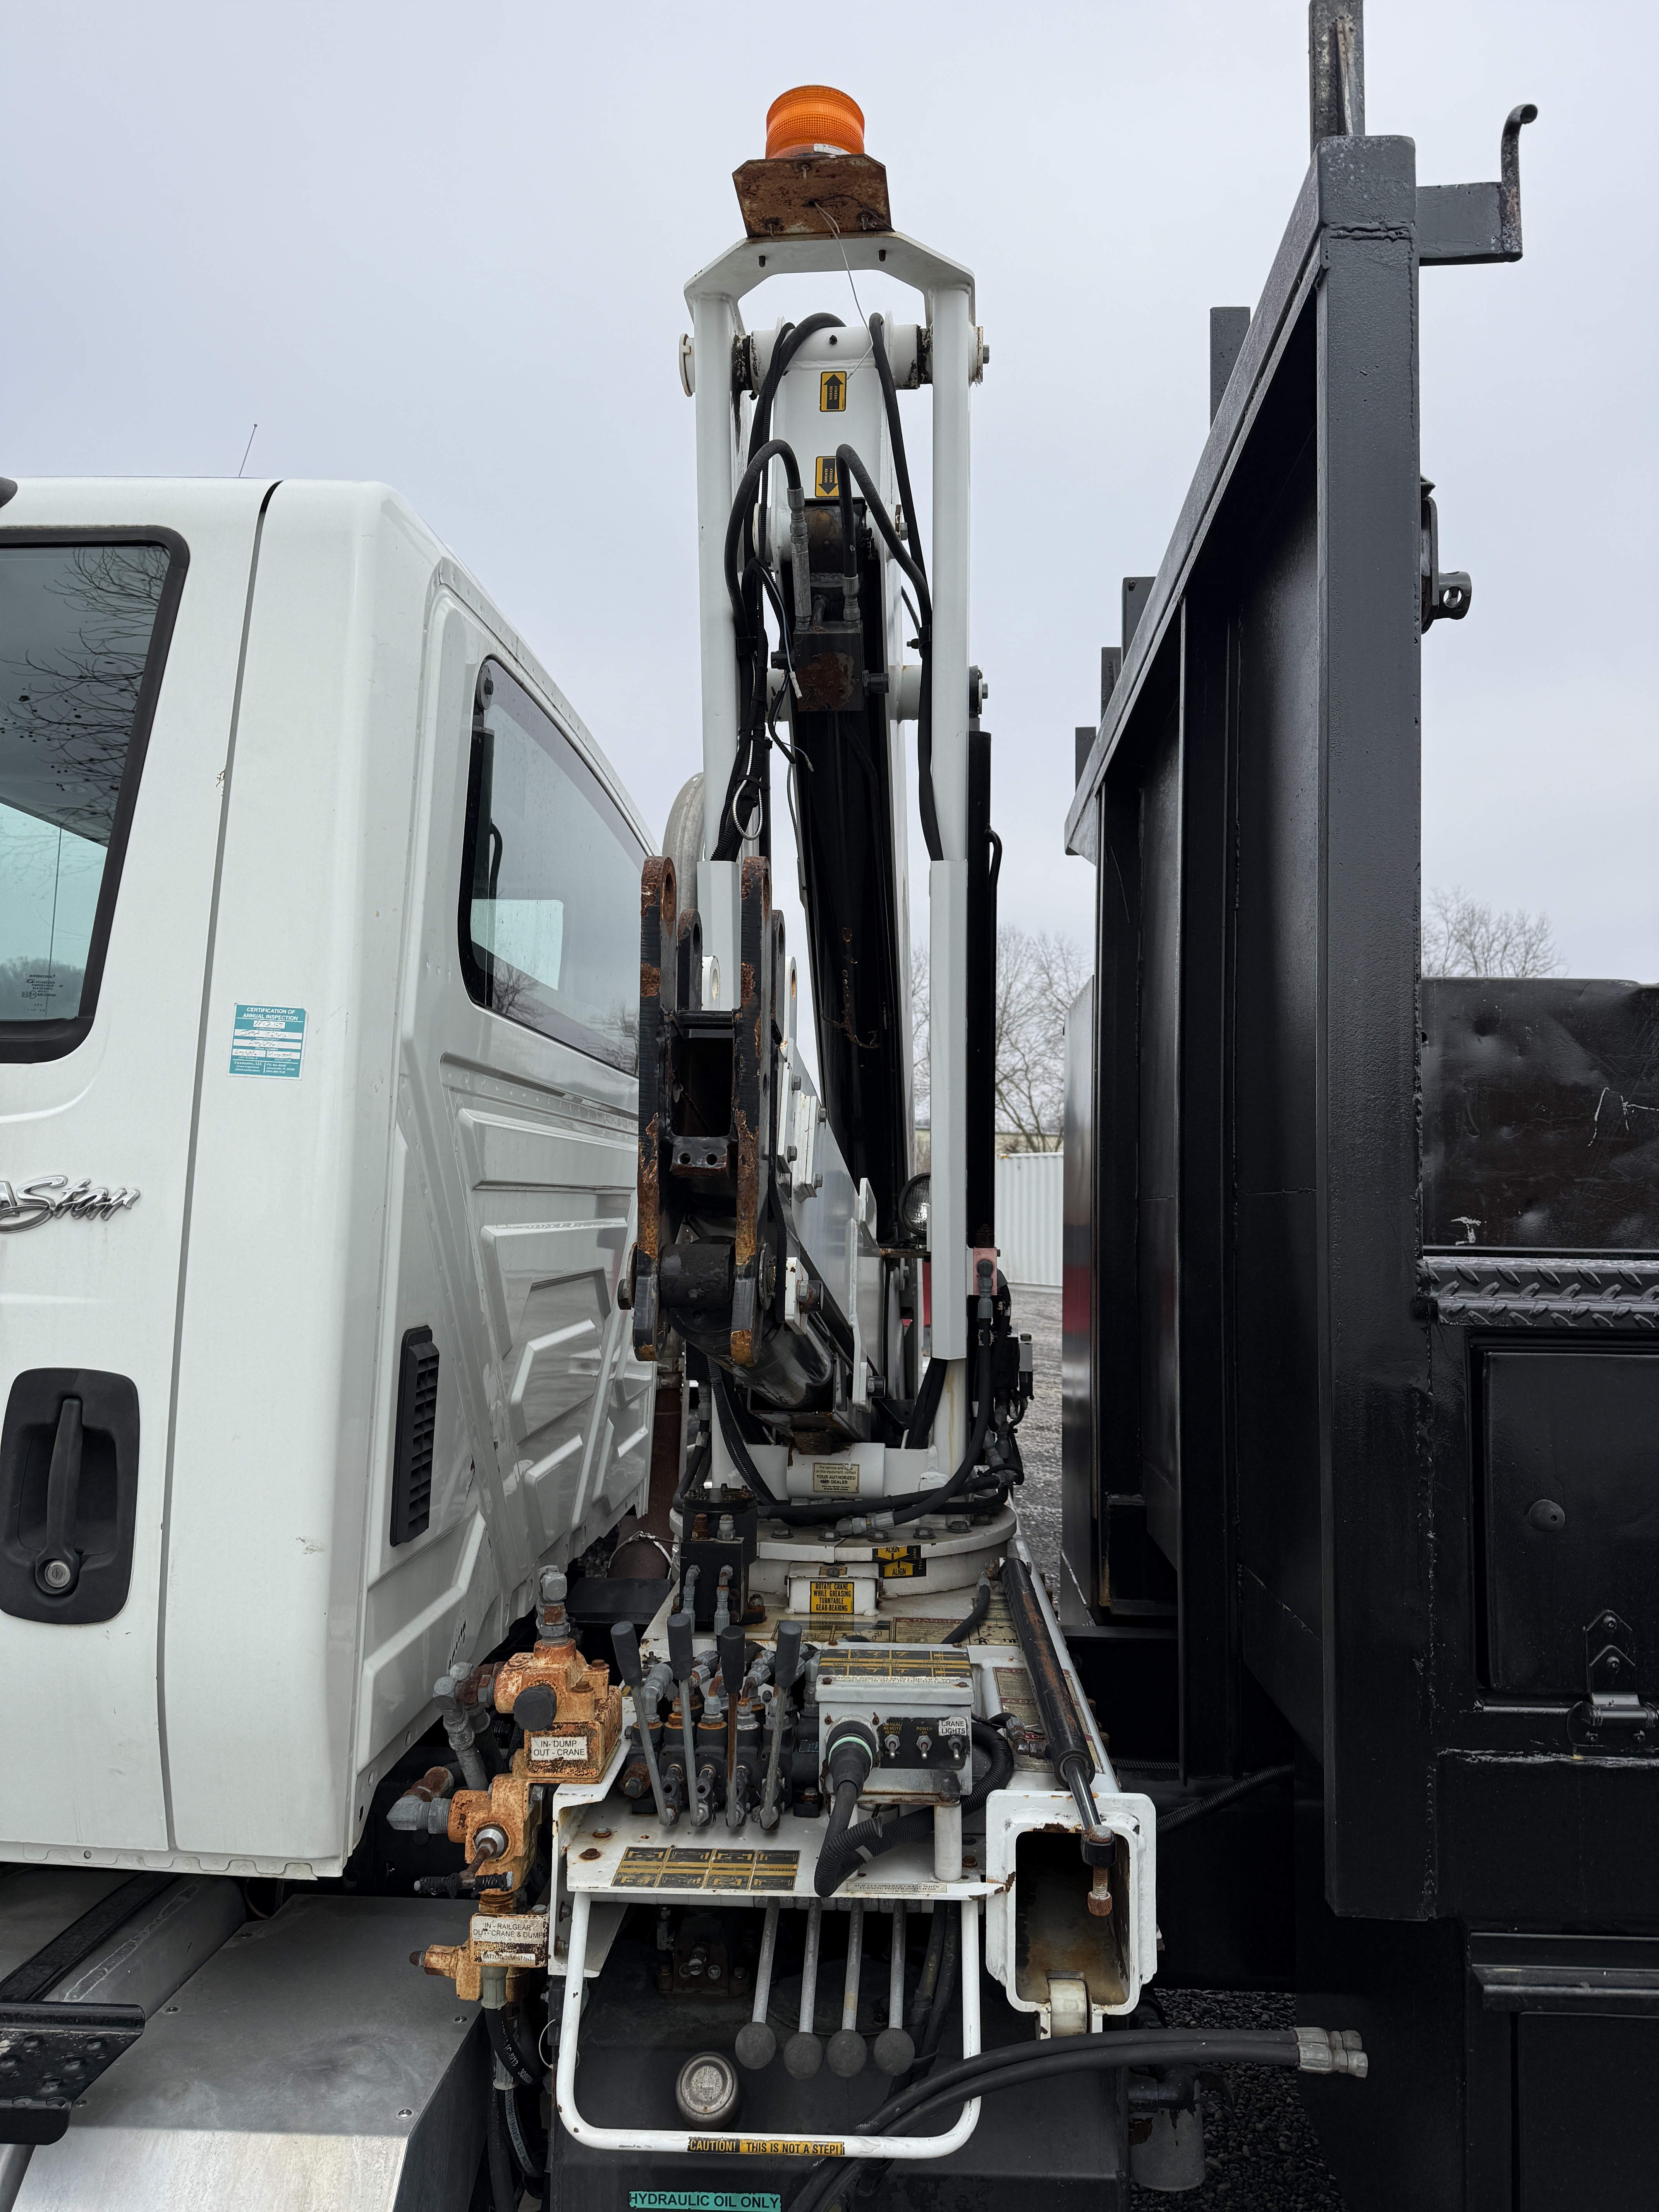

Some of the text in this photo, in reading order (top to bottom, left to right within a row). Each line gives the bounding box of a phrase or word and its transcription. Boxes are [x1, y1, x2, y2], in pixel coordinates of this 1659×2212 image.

[892, 1568, 906, 1576] ALIGN
[690, 2140, 838, 2154] CAUTION! THIS IS NOT A STEP!
[630, 2193, 779, 2209] HYDRAULIC OIL ONLY
